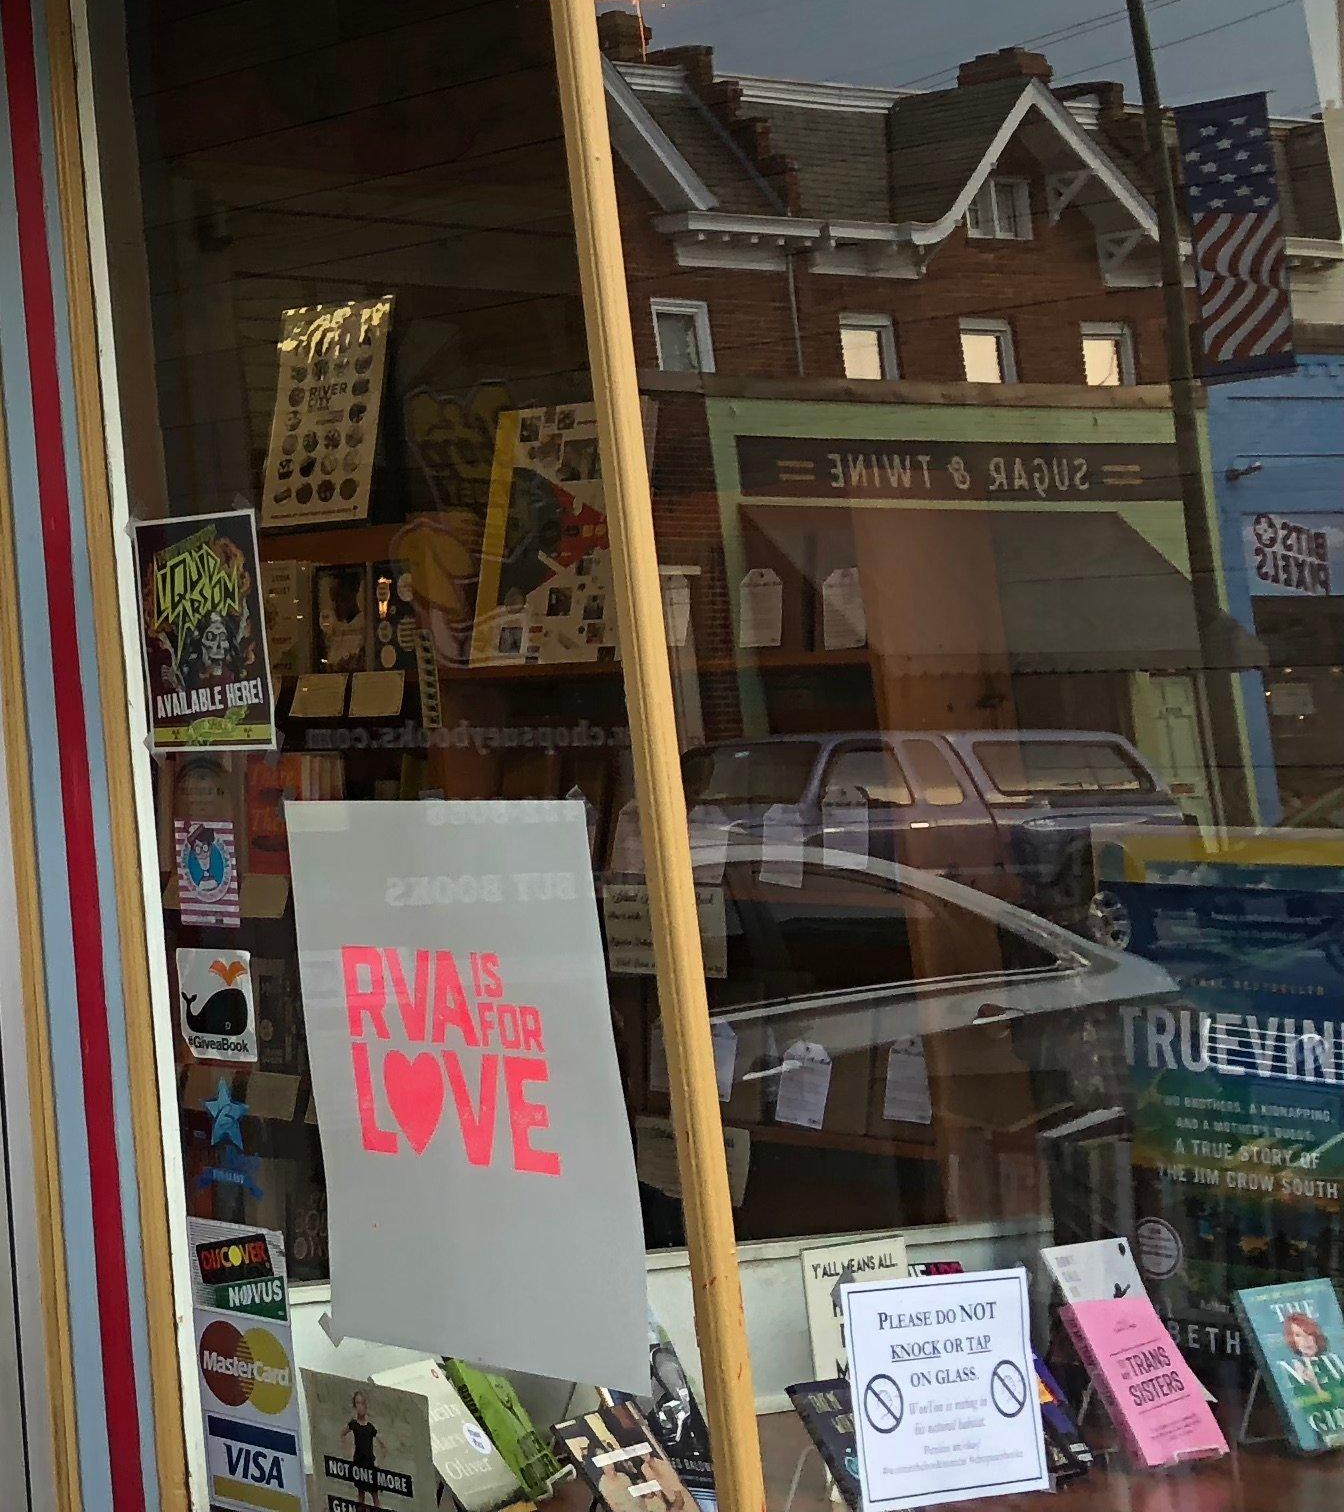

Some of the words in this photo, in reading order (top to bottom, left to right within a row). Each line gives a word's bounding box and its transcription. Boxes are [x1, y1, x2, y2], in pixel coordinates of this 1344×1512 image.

[157, 686, 224, 719] AVAILABLE
[226, 677, 263, 707] HERE!
[471, 952, 503, 998] IS
[341, 945, 481, 1048] RVA
[480, 1003, 546, 1054] FOR
[1119, 1006, 1344, 1085] TRUEVIN
[1192, 1139, 1233, 1160] TRUE
[936, 1308, 957, 1324] DO
[959, 1301, 997, 1323] NOT
[891, 1341, 942, 1361] KNOCK
[943, 1337, 964, 1354] OR
[967, 1334, 992, 1354] TAP
[1126, 1346, 1172, 1377] TRANS
[203, 1349, 290, 1387] MasterCard
[910, 1371, 932, 1388] ON
[936, 1366, 980, 1385] GLASS.
[1129, 1370, 1185, 1407] SISTERS
[223, 1442, 285, 1489] VISA
[329, 1460, 350, 1477] NOT
[353, 1465, 375, 1484] ONE
[377, 1471, 408, 1493] MORE
[446, 1458, 493, 1482] Oliver
